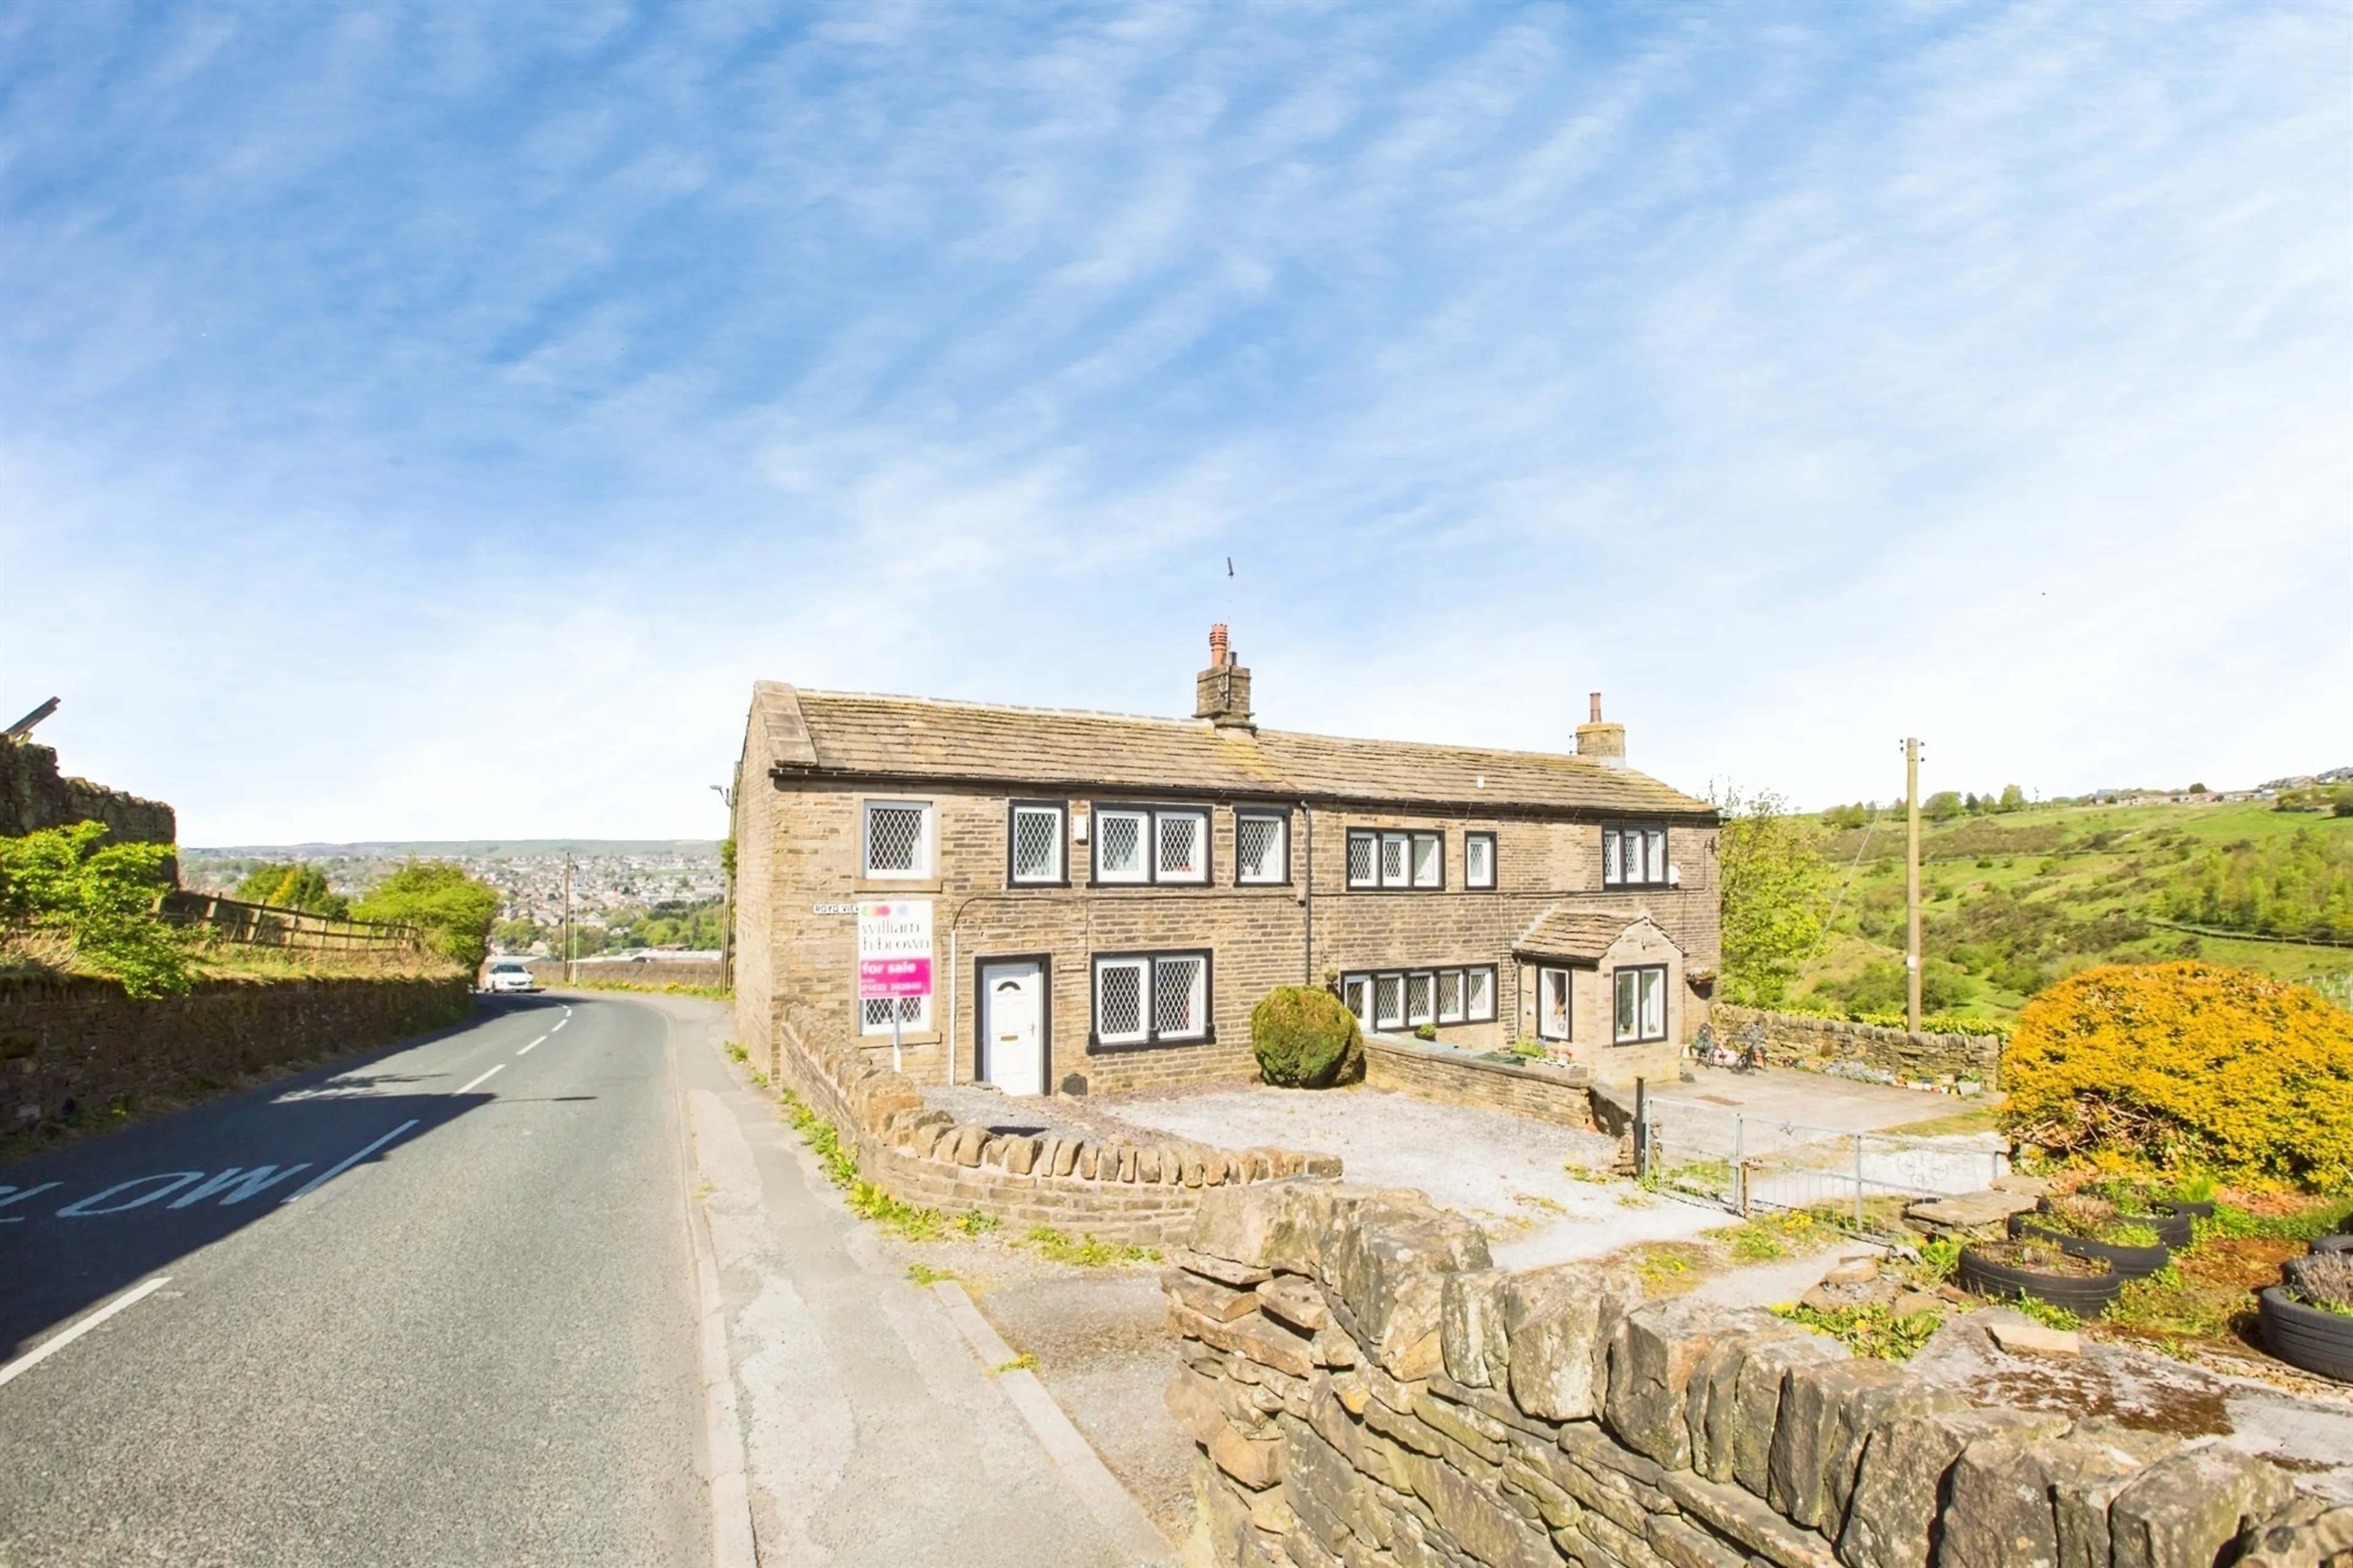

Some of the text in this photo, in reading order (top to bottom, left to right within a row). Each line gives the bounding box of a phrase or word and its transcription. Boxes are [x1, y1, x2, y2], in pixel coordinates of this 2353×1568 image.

[862, 920, 919, 934] william
[863, 936, 930, 951] h brown
[862, 961, 917, 975] for sale
[0, 1163, 314, 1222] LOW
